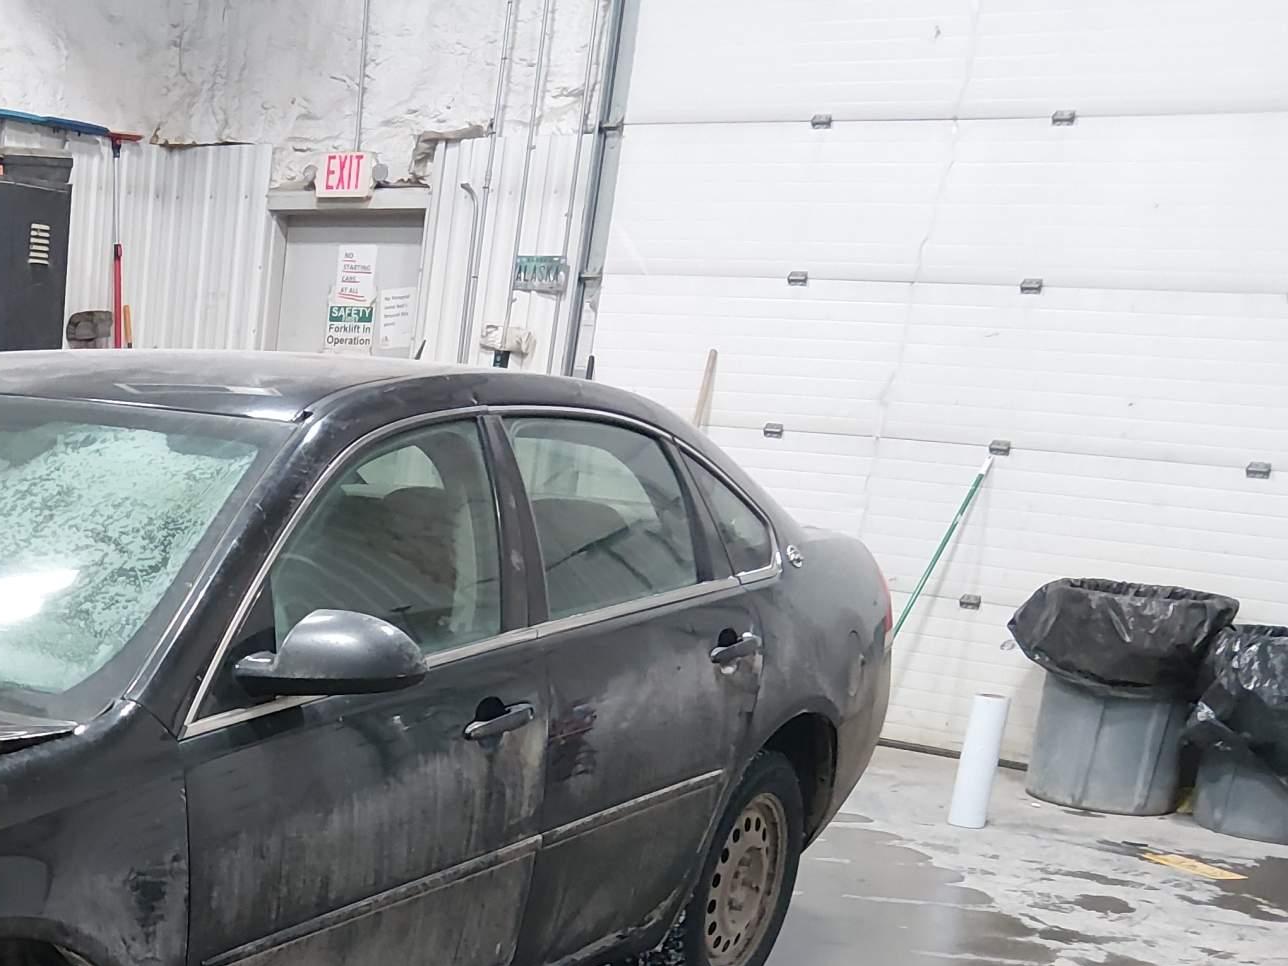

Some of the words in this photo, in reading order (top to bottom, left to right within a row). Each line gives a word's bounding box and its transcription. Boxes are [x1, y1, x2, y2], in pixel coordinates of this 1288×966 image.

[325, 154, 364, 190] EXIT
[515, 264, 560, 282] ALASKA
[331, 306, 371, 318] SAFETY
[329, 323, 360, 333] Forklift
[326, 335, 371, 347] Operation
